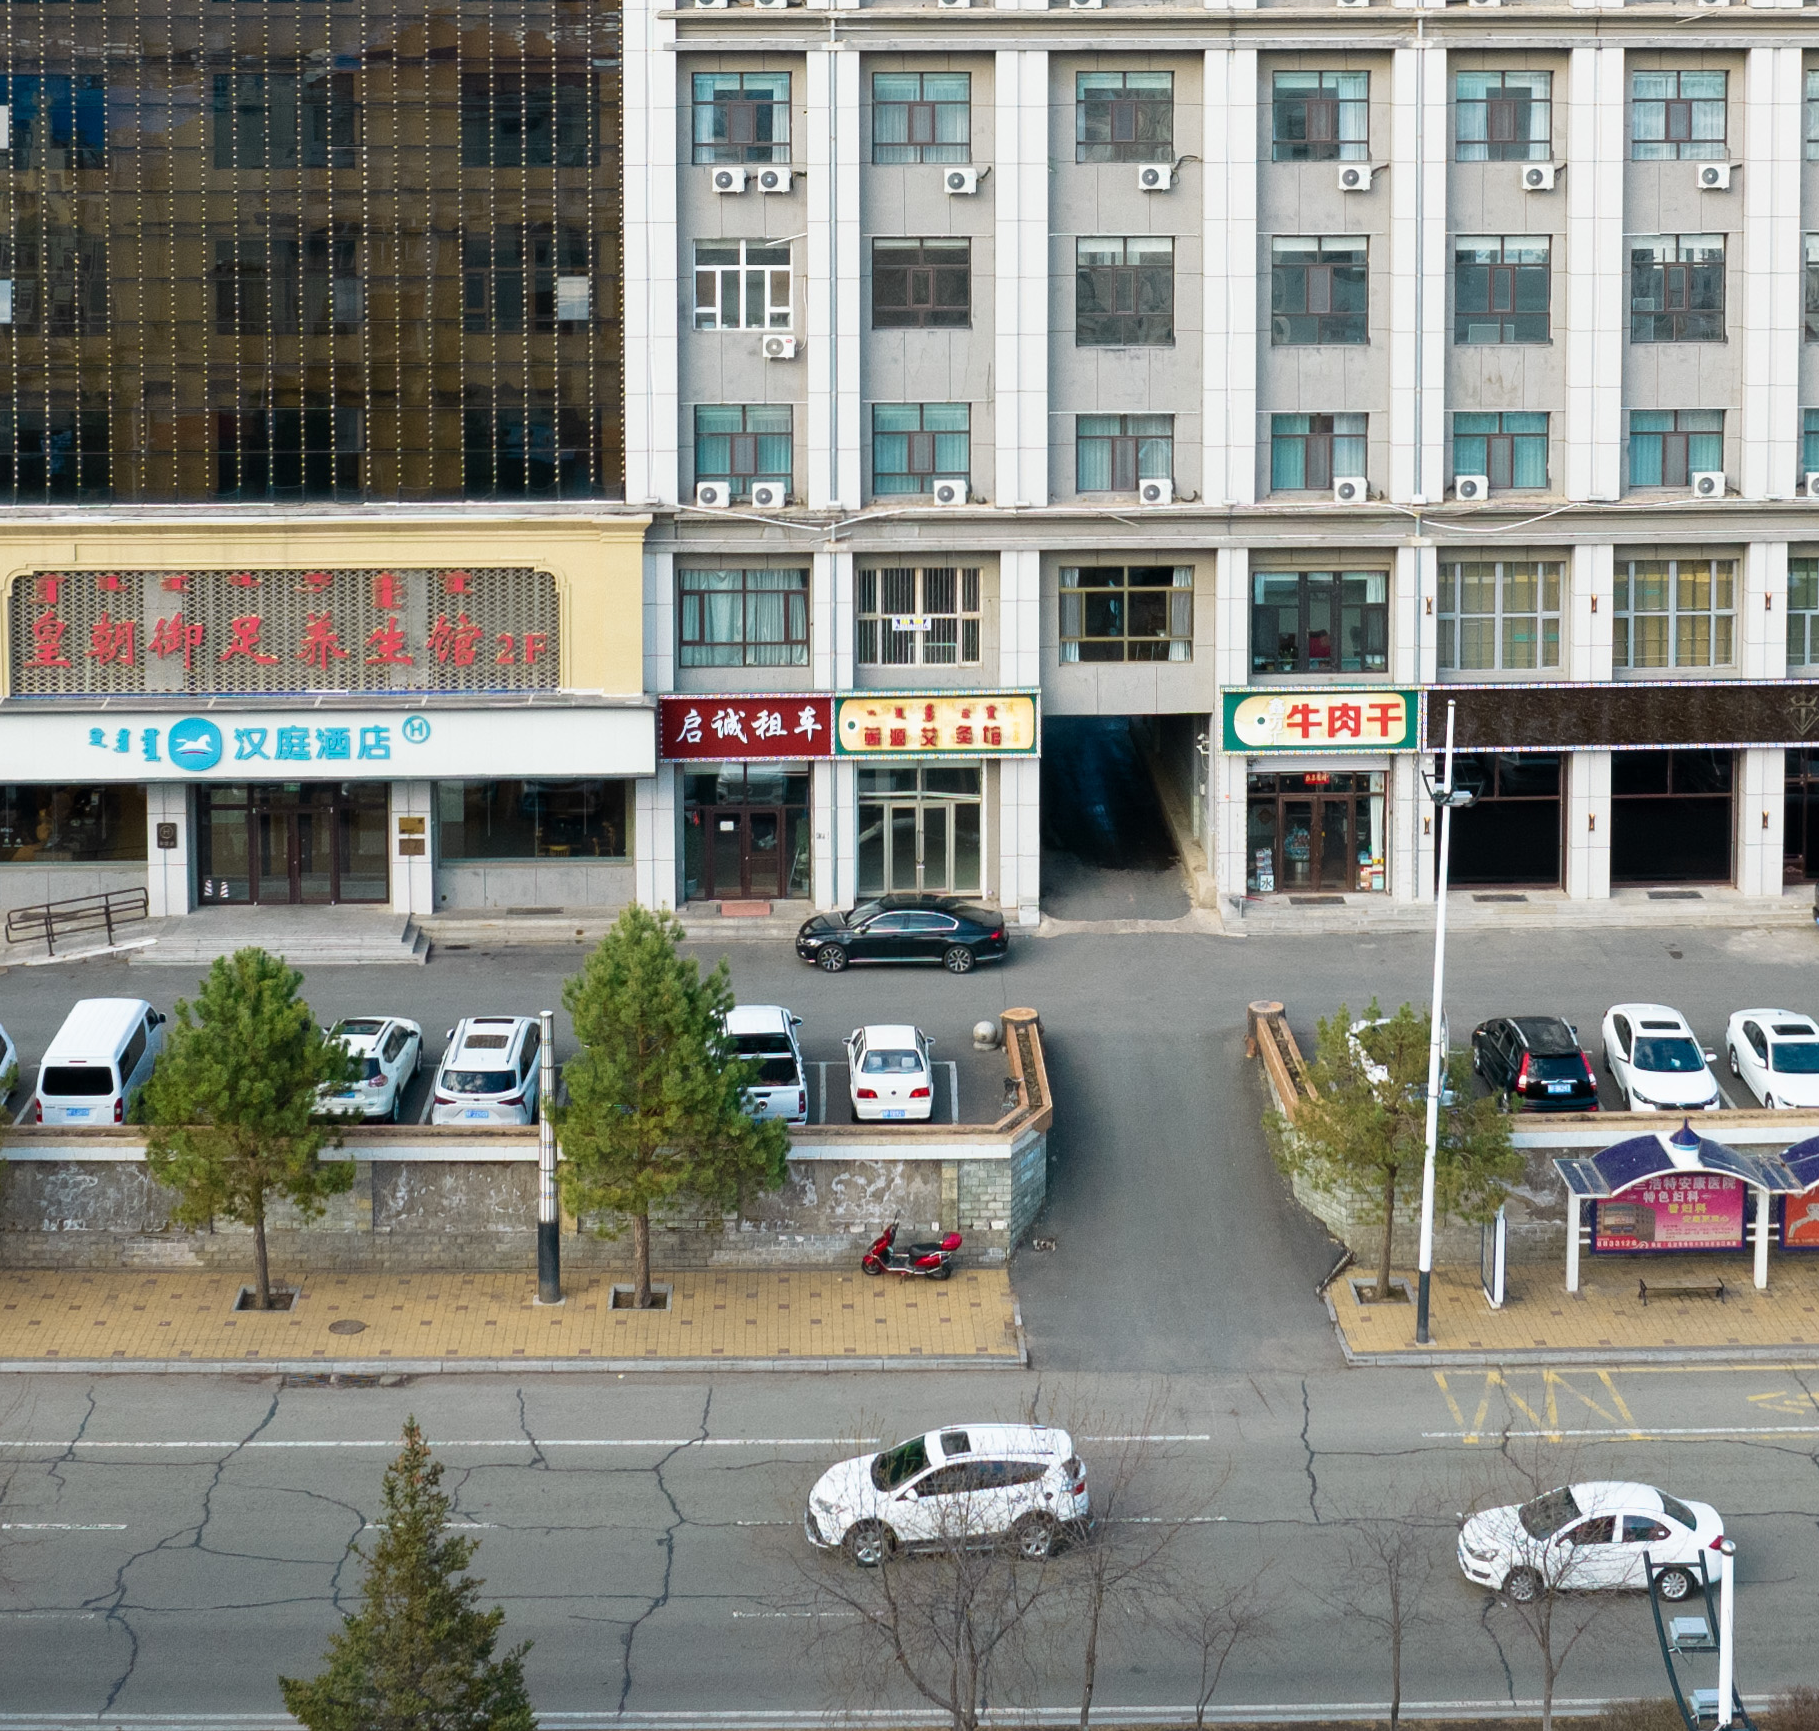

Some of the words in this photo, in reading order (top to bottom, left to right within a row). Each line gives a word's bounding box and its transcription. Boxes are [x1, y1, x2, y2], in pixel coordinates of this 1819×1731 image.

[23, 611, 484, 671] 皇朝御足养生馆
[496, 631, 548, 666] 2F
[676, 706, 823, 745] 启诚租车
[1286, 702, 1403, 739] 牛肉干
[234, 725, 392, 761] 汉庭酒店
[1261, 877, 1273, 890] 水
[1625, 1176, 1737, 1192] 兰浩特安康医院
